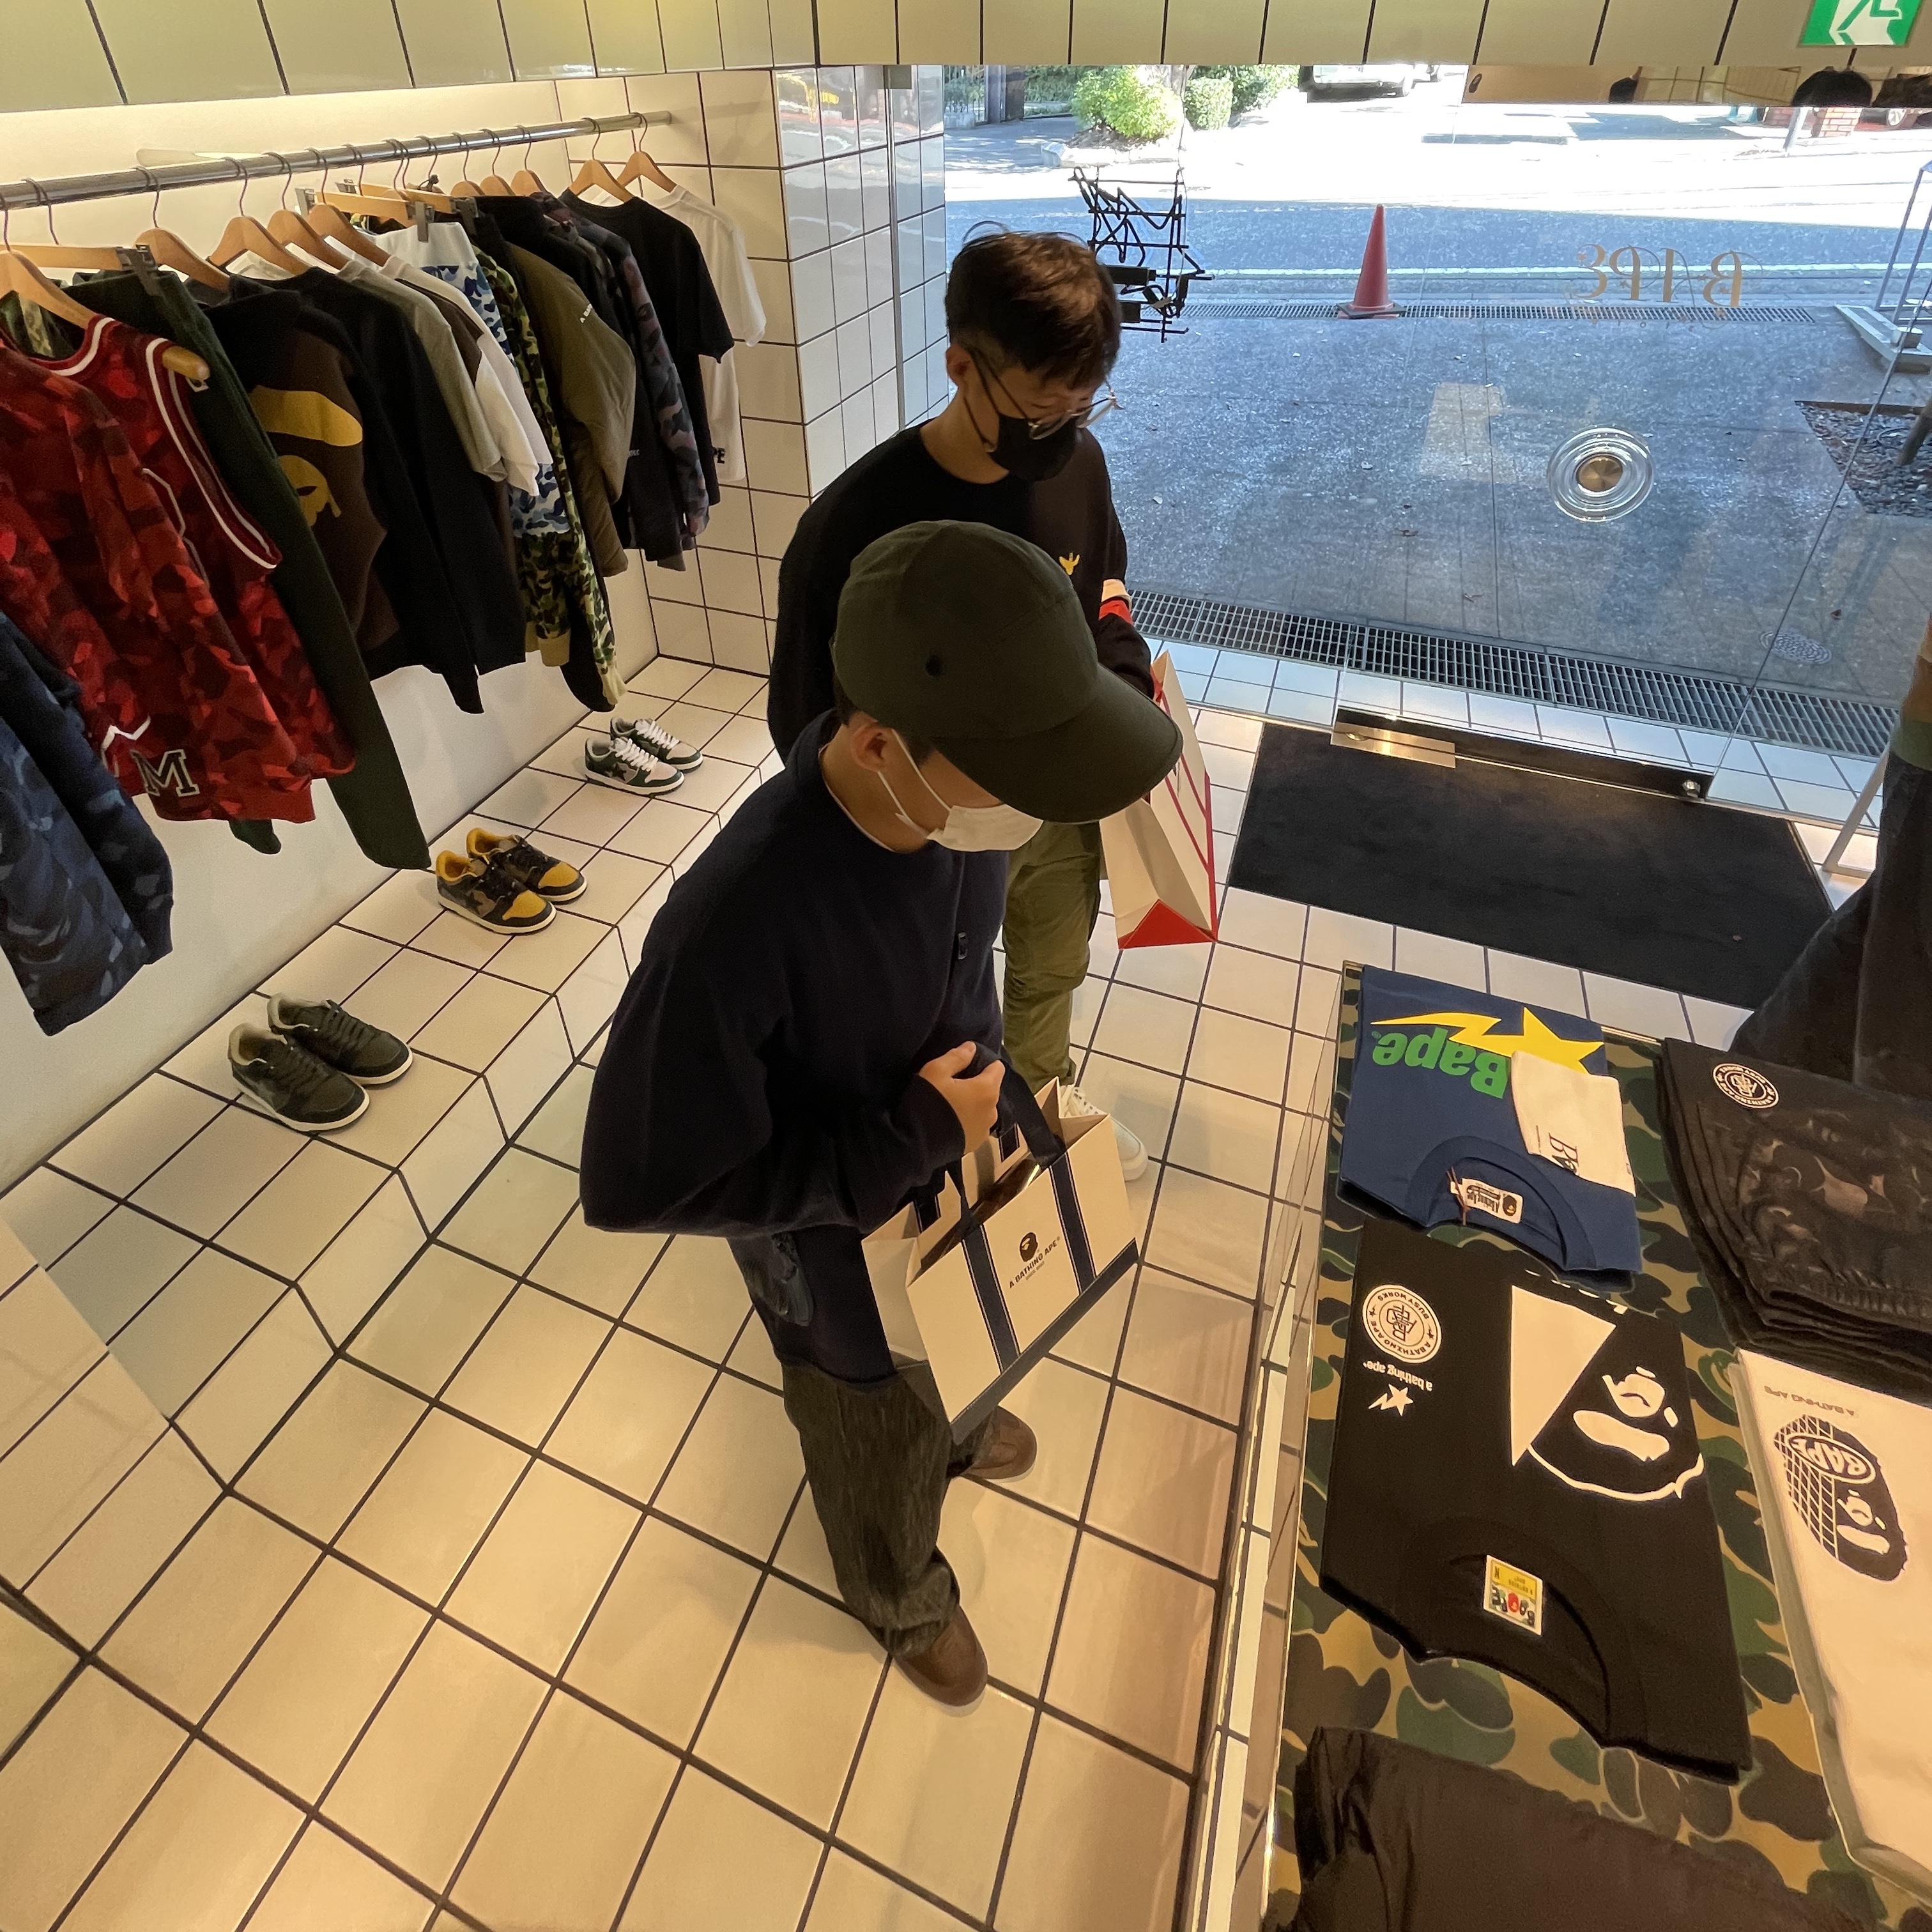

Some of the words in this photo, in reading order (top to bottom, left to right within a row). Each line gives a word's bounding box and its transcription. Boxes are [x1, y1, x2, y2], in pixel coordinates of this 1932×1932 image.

[130, 749, 200, 797] M
[1009, 1280, 1015, 1289] A
[1015, 1253, 1043, 1283] BATHING
[1377, 1291, 1407, 1301] WORKS
[1407, 1298, 1430, 1320] BUSY
[1370, 1321, 1384, 1339] APE
[1386, 1363, 1425, 1391] bathing
[1425, 1380, 1434, 1392] a
[1789, 1438, 1868, 1476] BAPE
